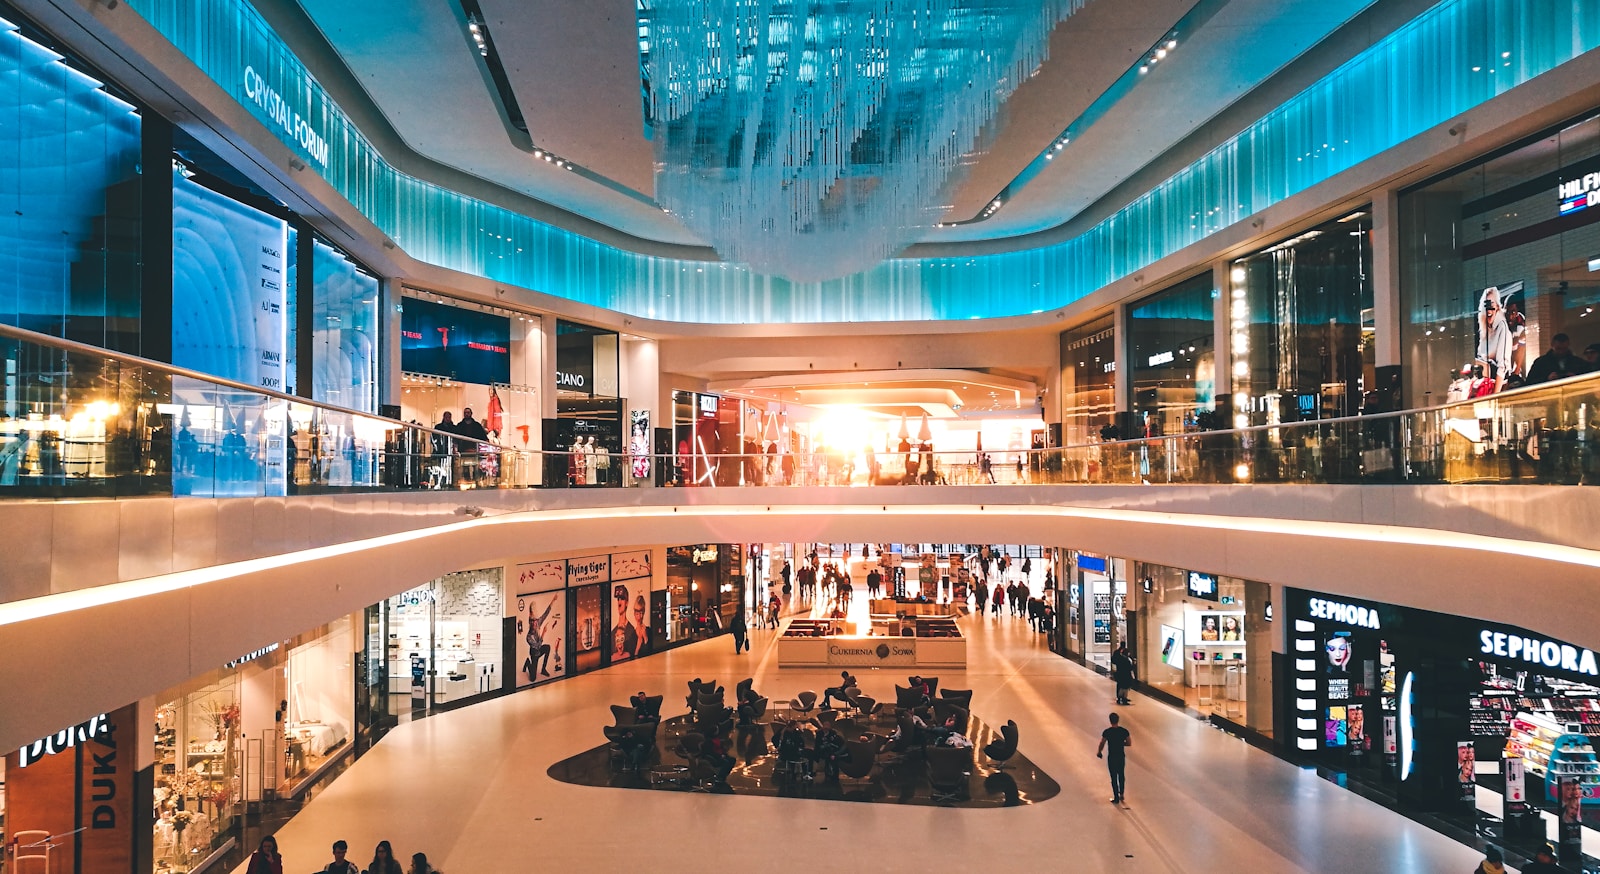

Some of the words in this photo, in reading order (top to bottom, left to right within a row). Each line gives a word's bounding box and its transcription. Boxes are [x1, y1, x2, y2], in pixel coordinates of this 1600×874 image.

[244, 65, 292, 136] CRYSTAL
[294, 112, 328, 168] FORUM
[1559, 171, 1600, 199] HILFI
[262, 350, 280, 361] ARMANI
[261, 377, 280, 388] JOOP!
[556, 371, 584, 387] CIANO
[568, 564, 588, 577] flying
[589, 561, 606, 574] tiger
[1309, 597, 1381, 630] SEPHORA
[1480, 629, 1599, 676] SEPHORA
[92, 722, 116, 829] DUKA
